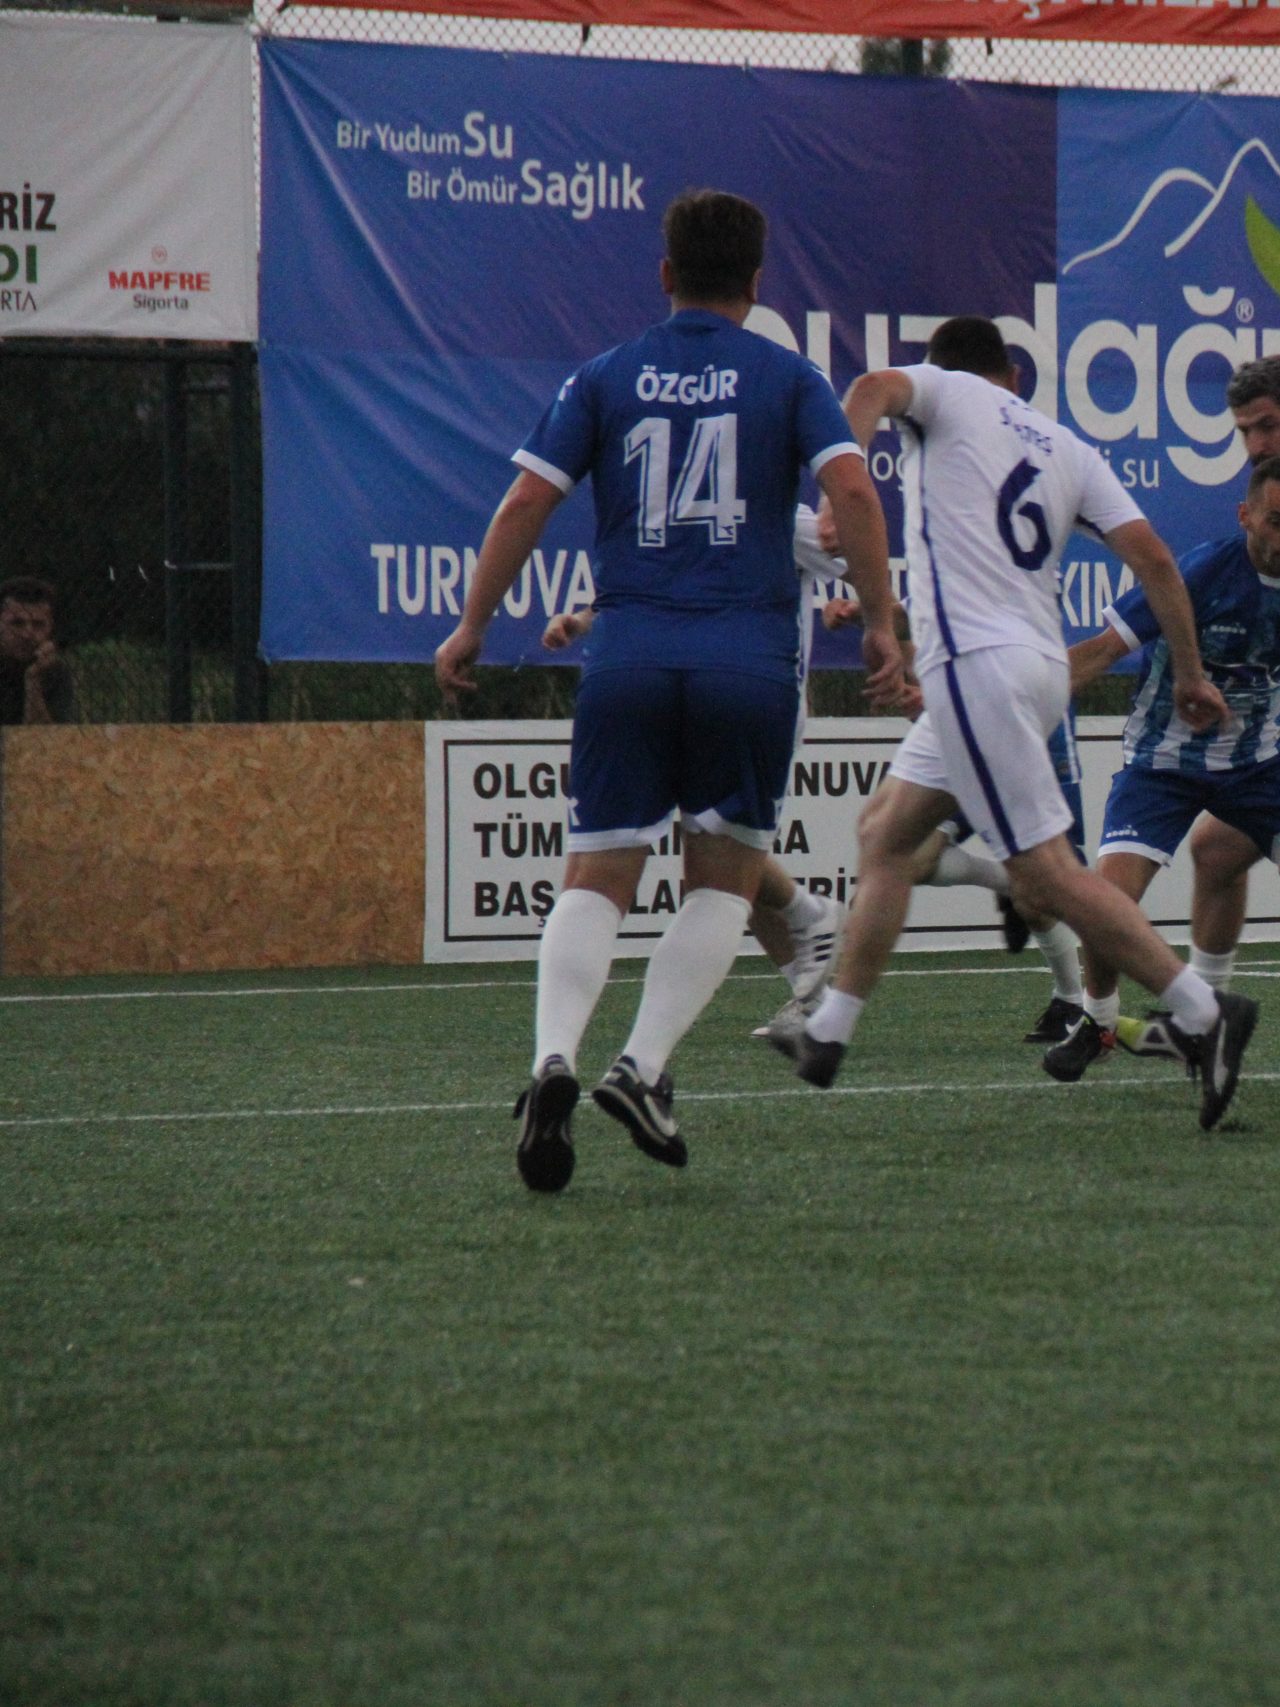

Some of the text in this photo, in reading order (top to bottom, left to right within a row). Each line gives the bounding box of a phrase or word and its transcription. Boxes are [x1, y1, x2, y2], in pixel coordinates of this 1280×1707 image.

[337, 111, 513, 159] Bir Yudum Su
[0, 182, 57, 231] RİZ
[406, 159, 645, 220] Bir Ömür Sağlık
[108, 271, 211, 292] MAPFRE
[132, 293, 189, 312] Sigorta
[636, 364, 739, 405] ÖZGÜR
[623, 412, 747, 548] 14
[996, 457, 1053, 571] 6
[473, 812, 563, 858] TÜM
